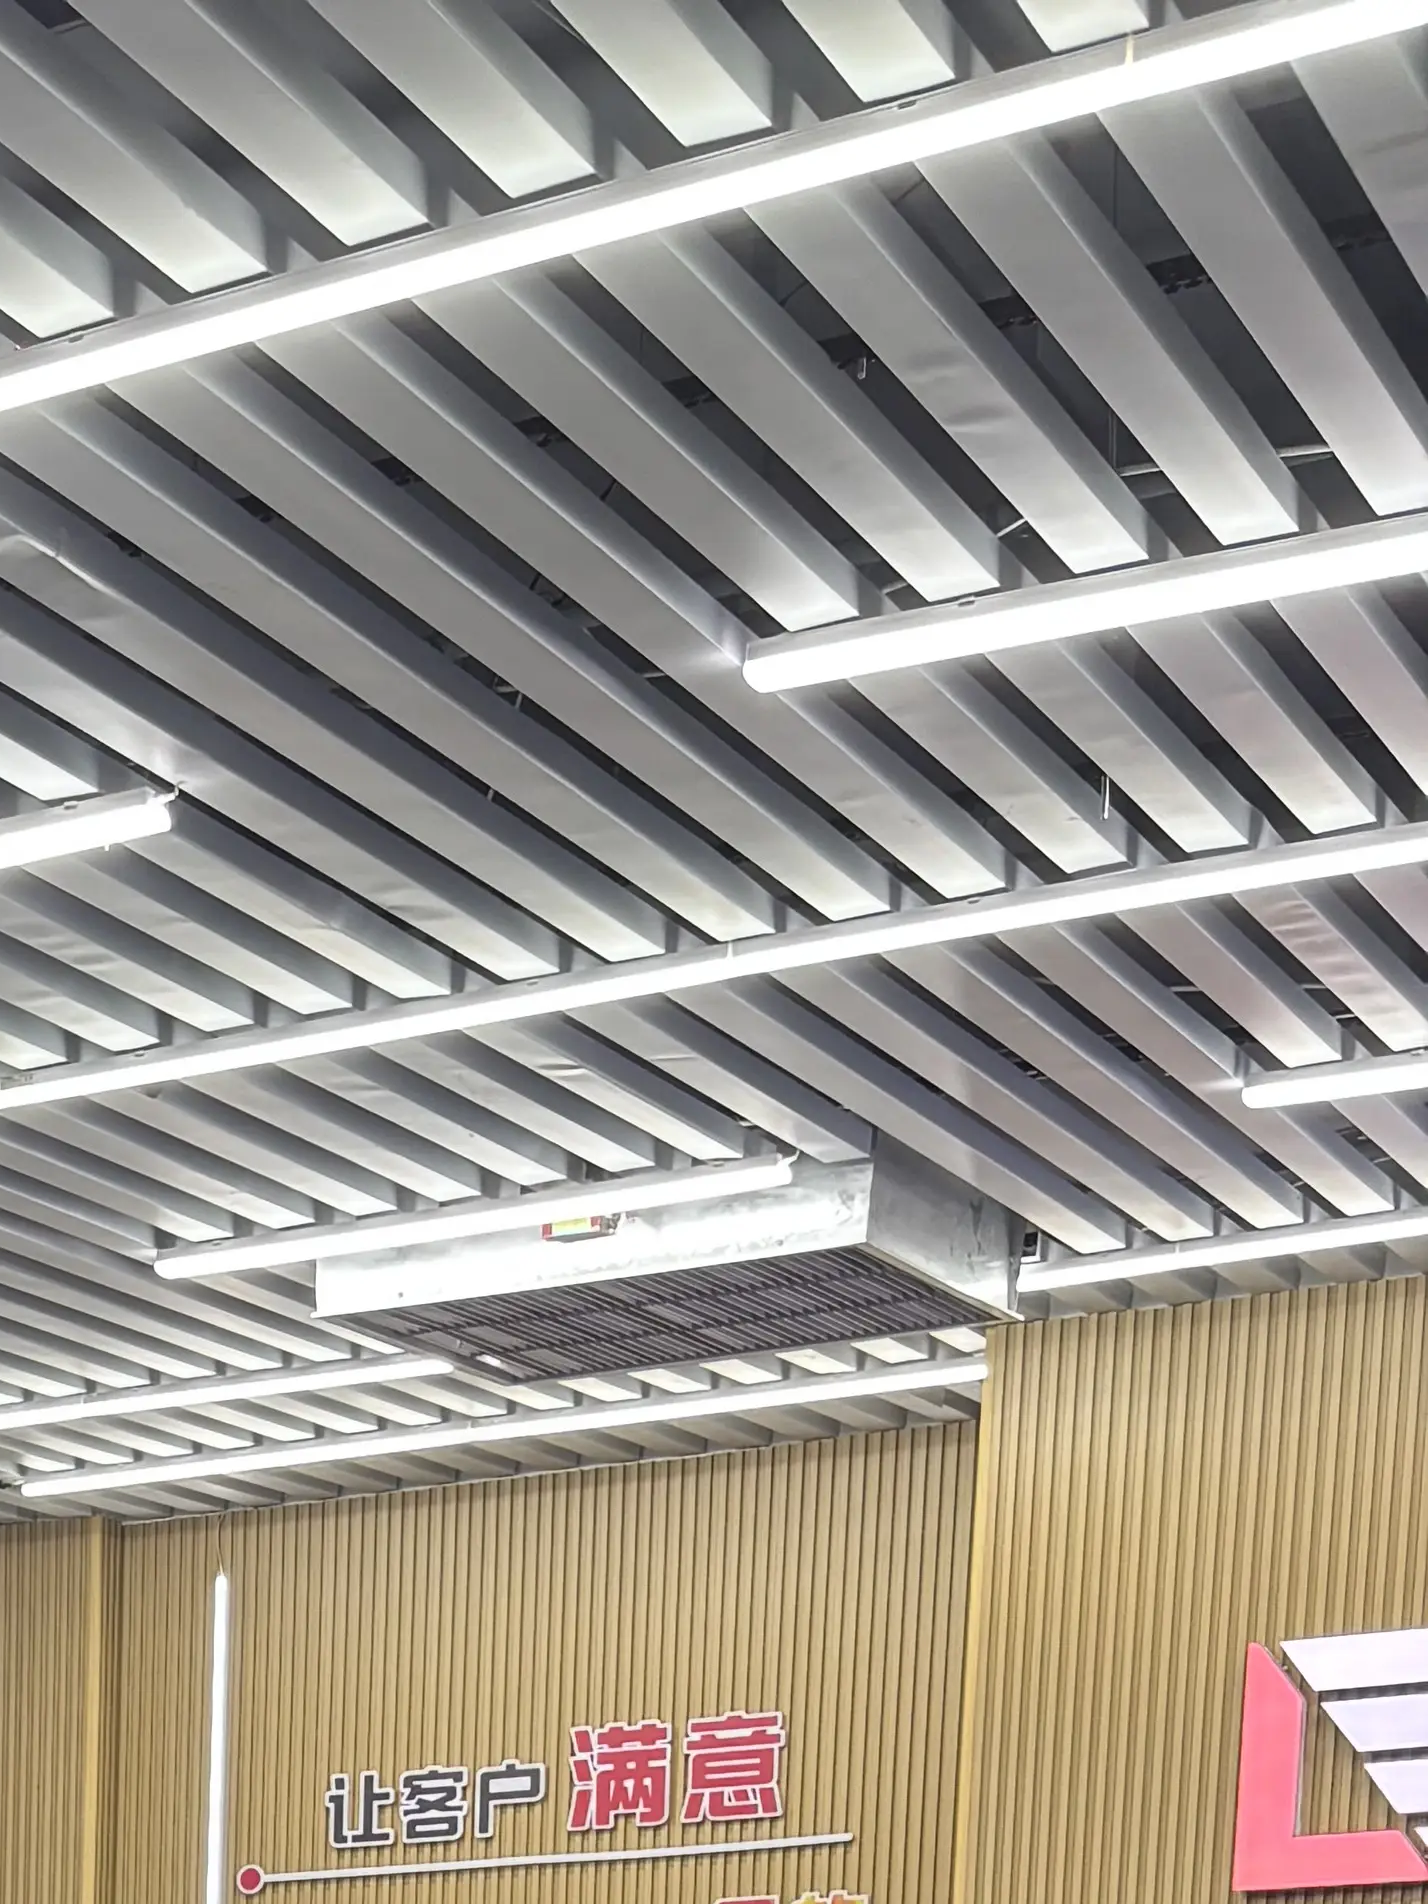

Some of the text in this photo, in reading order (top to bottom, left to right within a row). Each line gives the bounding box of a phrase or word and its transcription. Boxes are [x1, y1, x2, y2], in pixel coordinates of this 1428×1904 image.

[325, 1710, 786, 1849] 让客户满意
